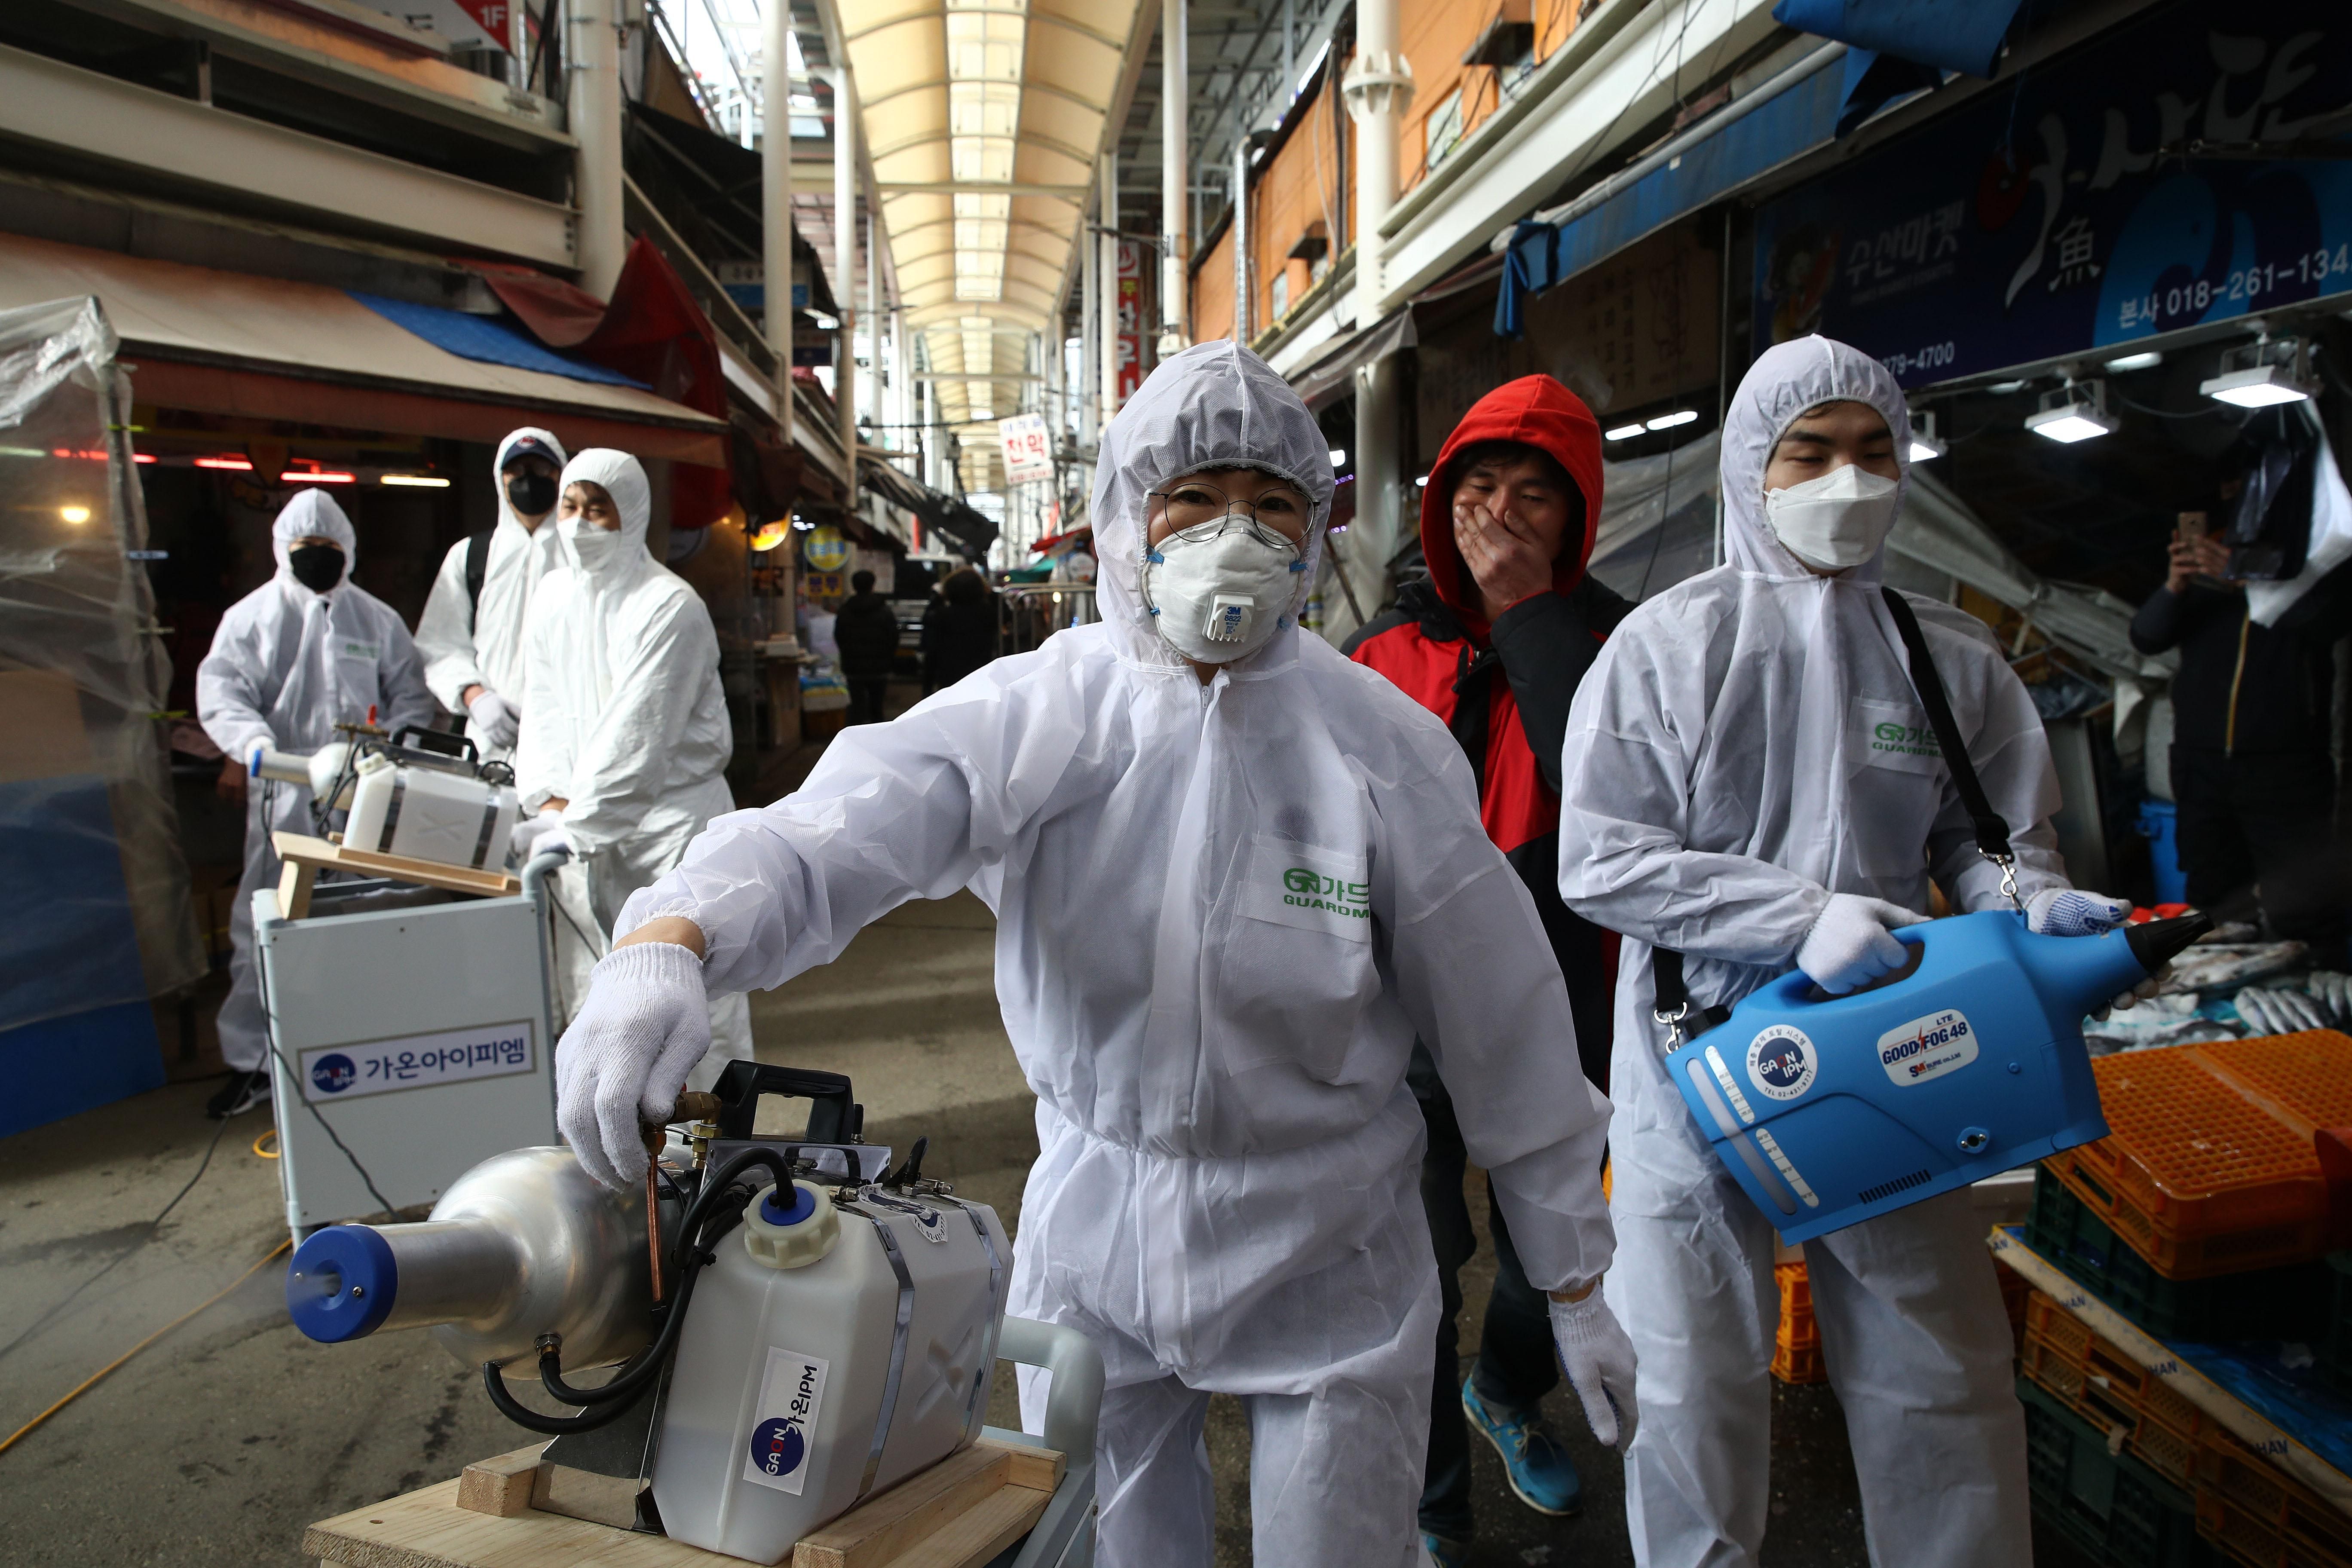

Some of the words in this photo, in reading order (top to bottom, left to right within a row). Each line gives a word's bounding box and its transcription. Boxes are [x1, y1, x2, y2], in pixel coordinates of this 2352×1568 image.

[480, 5, 506, 28] 1F
[2048, 215, 2102, 293] 魚
[2118, 292, 2161, 329] 본사
[2166, 242, 2352, 317] 018-261-134
[1227, 606, 1241, 615] 3M
[1936, 1014, 1954, 1026] LTE
[1882, 1040, 1920, 1065] GOOD
[1923, 1029, 1949, 1050] FOG
[1950, 1022, 1968, 1038] 48
[364, 1037, 525, 1081] 가온아이피엠
[1759, 1050, 1797, 1075] GAON
[1782, 1059, 1807, 1078] IPM
[1764, 1087, 1775, 1096] TEL
[913, 1217, 924, 1233] TEL
[786, 1364, 818, 1435] 가온IPM
[766, 1427, 787, 1476] GAON
